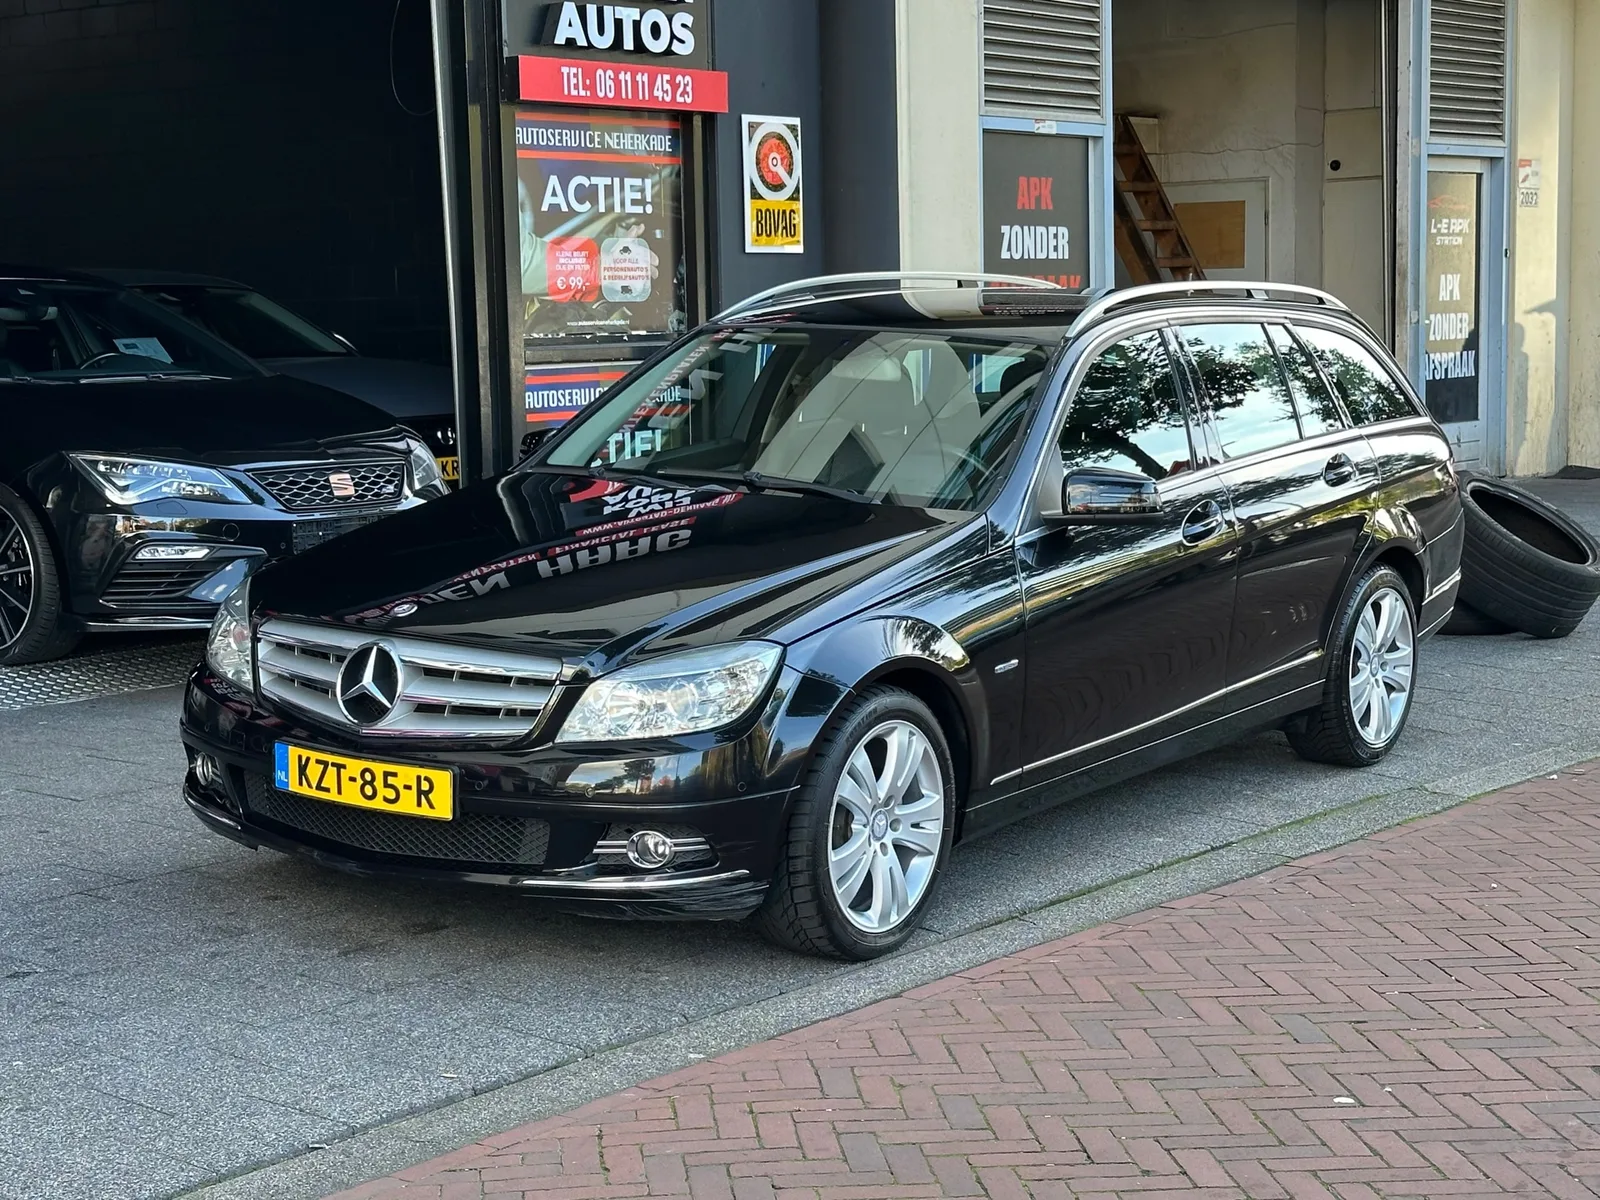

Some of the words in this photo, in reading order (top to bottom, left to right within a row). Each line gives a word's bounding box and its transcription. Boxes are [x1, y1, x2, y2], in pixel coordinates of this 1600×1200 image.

[554, 1, 695, 56] AUTOS
[561, 66, 591, 97] TEL:
[595, 68, 615, 99] 06
[618, 70, 632, 99] 11
[635, 72, 649, 101] 11
[653, 73, 672, 102] 45
[675, 74, 693, 104] 23
[516, 127, 601, 148] AUTOSERVICE
[604, 131, 673, 152] NEHERKADE
[540, 175, 653, 214] ACTIE!
[1016, 176, 1054, 210] APK
[755, 208, 797, 239] BOVAG
[1000, 225, 1069, 260] ZONDER
[1439, 274, 1460, 301] APK
[1429, 312, 1469, 341] ZONDER
[1425, 350, 1475, 380] AFSPRAAK
[277, 769, 288, 782] NL
[297, 754, 436, 810] KZT-85-R
